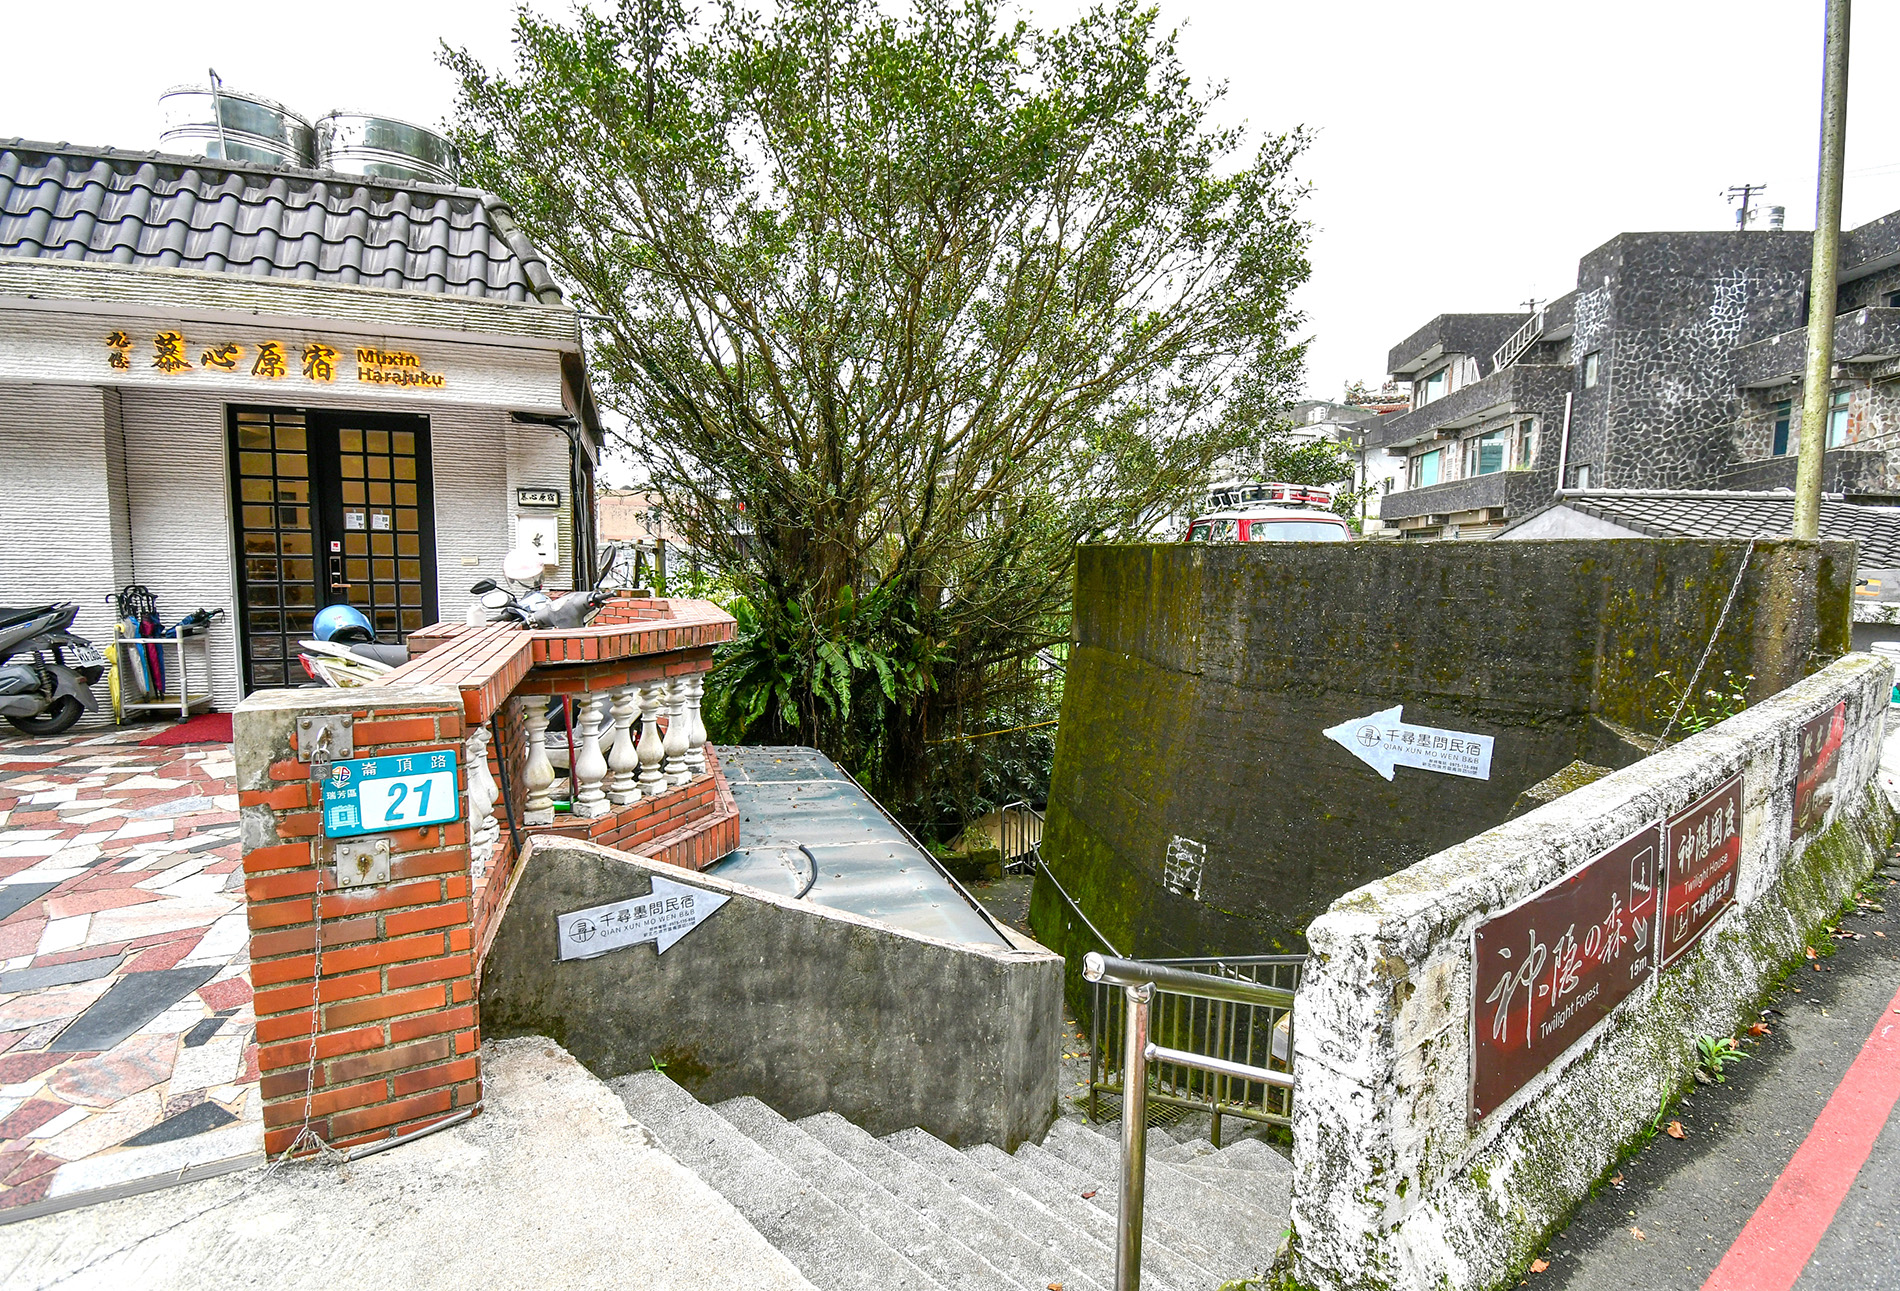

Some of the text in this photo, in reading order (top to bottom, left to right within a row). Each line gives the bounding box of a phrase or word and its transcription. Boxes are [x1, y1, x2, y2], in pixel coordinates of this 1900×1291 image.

[357, 349, 419, 367] Muxin
[357, 366, 444, 387] Harajuku
[1383, 743, 1403, 751] QIAN
[1405, 747, 1422, 755] XUN
[1440, 752, 1459, 761] WEN
[1462, 755, 1479, 764] B&B
[1386, 729, 1481, 756] 千尋墨問民宿
[361, 755, 446, 777] 崙頂路
[326, 788, 358, 800] 瑞芳區
[384, 779, 432, 821] 21
[1677, 797, 1735, 874] 神隱國度
[1684, 853, 1728, 895] Twilight House
[600, 894, 694, 927] 千尋墨問民宿
[600, 926, 621, 937] QIAN
[623, 922, 641, 932] XUN
[643, 918, 656, 926] MO
[658, 913, 676, 923] WEN
[679, 909, 695, 918] B&B
[1629, 956, 1647, 980] 15m
[1540, 982, 1599, 1039] Twilight Forest
